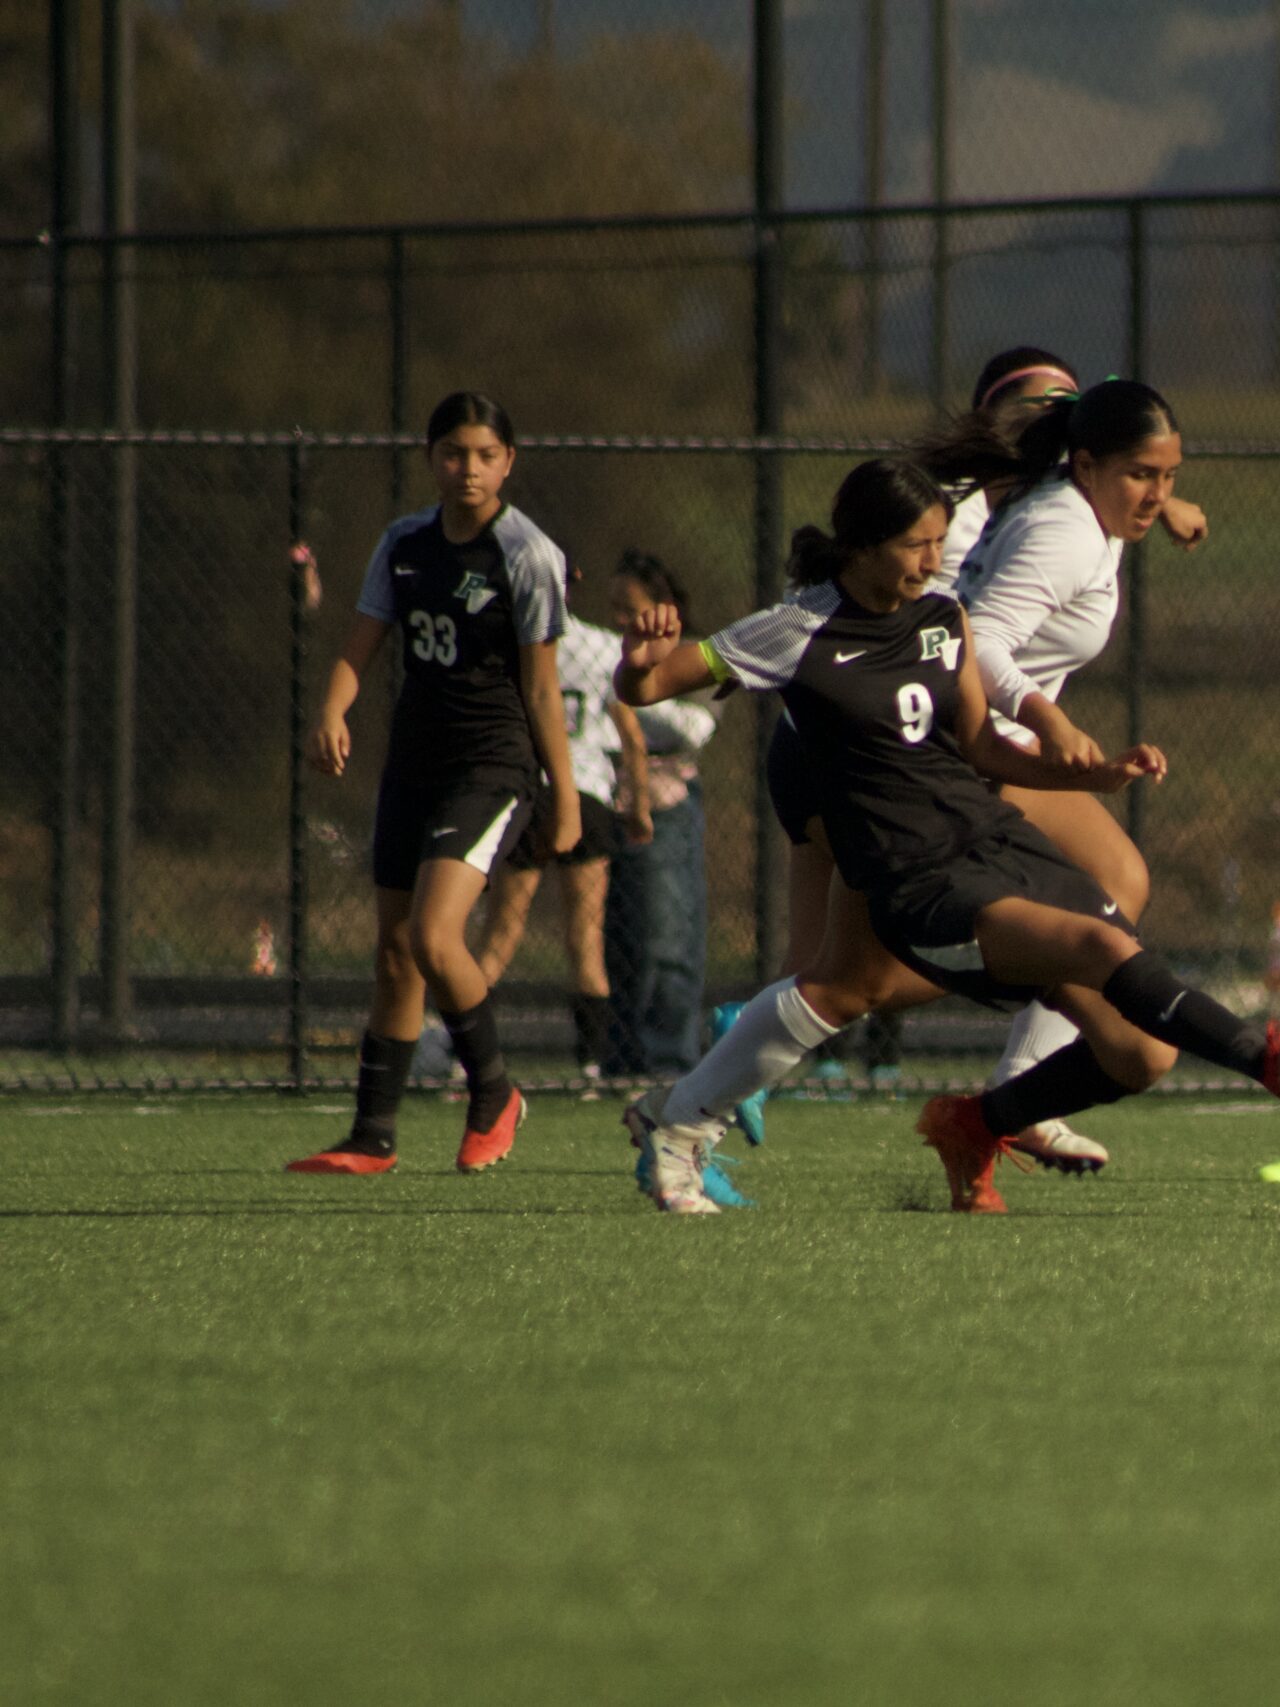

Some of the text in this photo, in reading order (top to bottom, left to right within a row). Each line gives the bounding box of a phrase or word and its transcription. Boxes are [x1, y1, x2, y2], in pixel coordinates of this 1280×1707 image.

[452, 570, 498, 614] PV
[408, 610, 458, 668] 33
[919, 626, 962, 671] PV
[897, 682, 934, 744] 9
